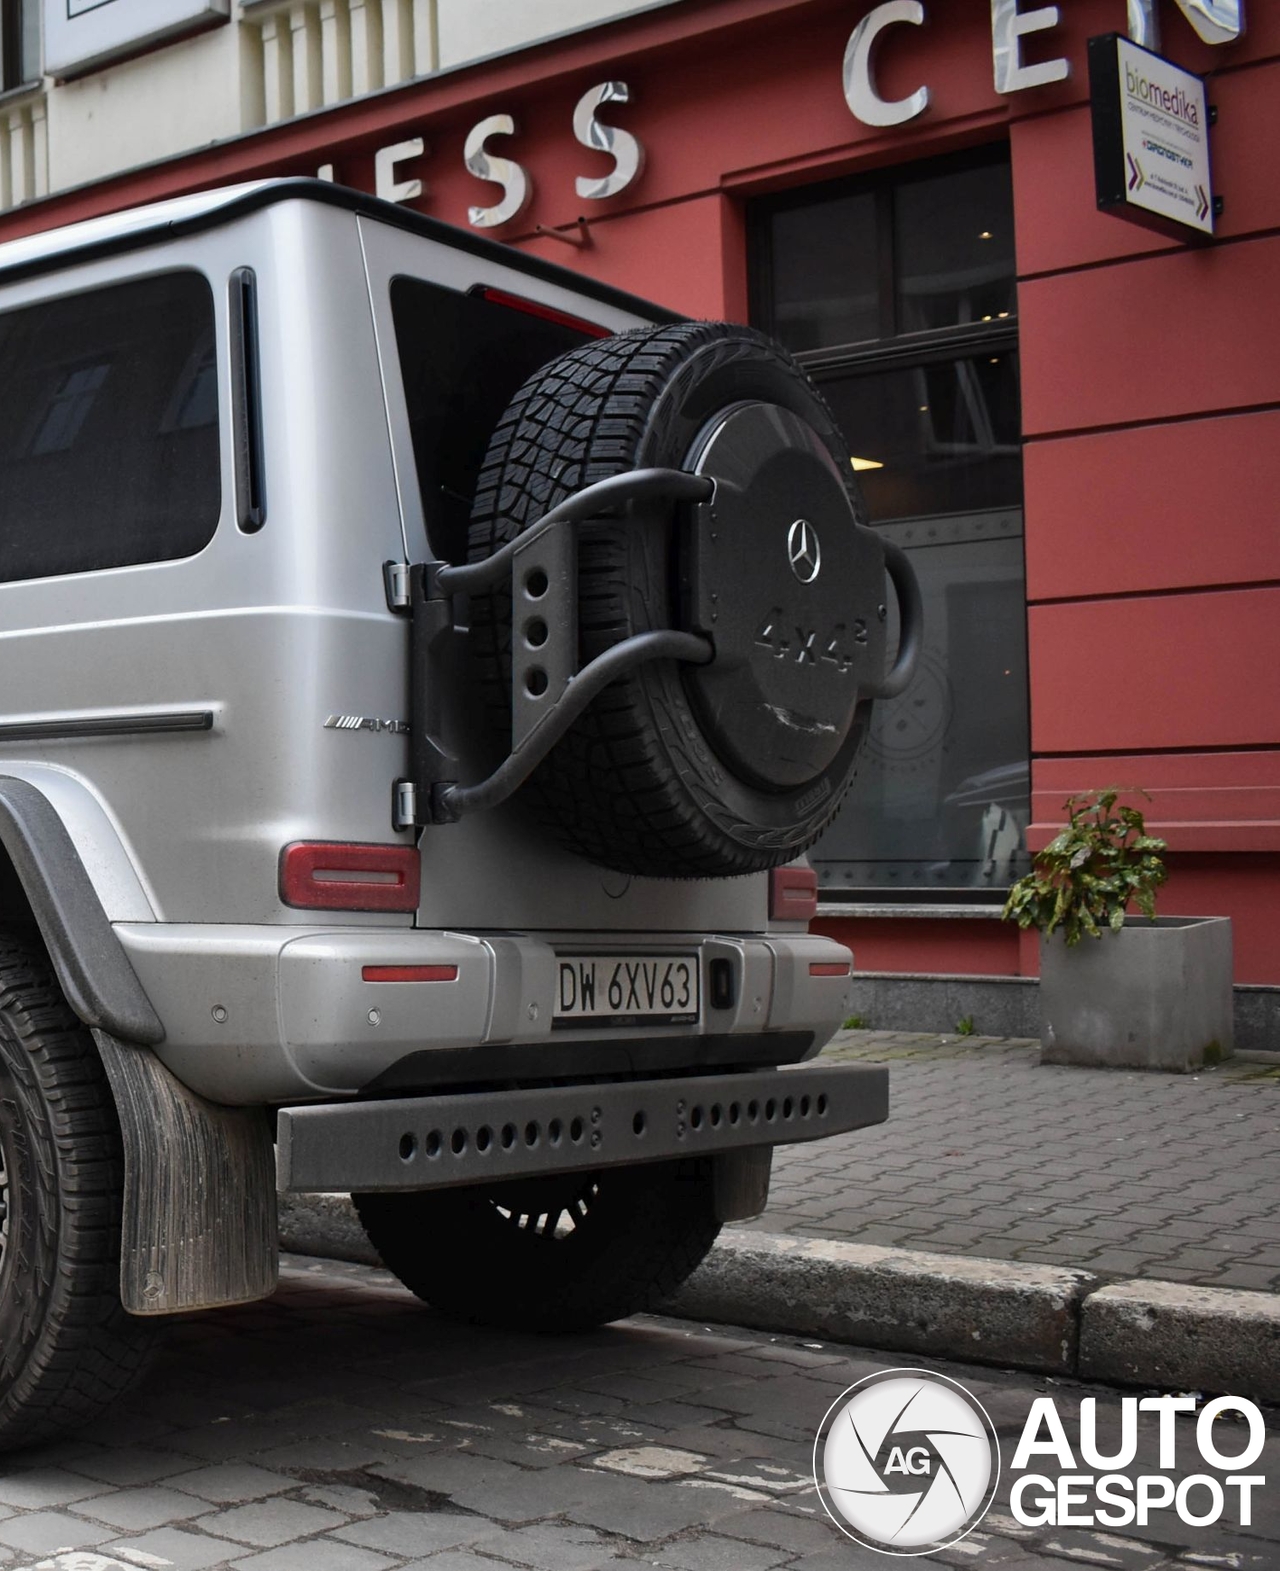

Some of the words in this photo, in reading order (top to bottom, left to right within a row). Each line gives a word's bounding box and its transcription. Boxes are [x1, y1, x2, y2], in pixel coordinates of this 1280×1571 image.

[1124, 61, 1199, 125] biomedika
[317, 80, 646, 229] ESS
[559, 962, 596, 1012] DW
[607, 962, 691, 1011] 6XV63
